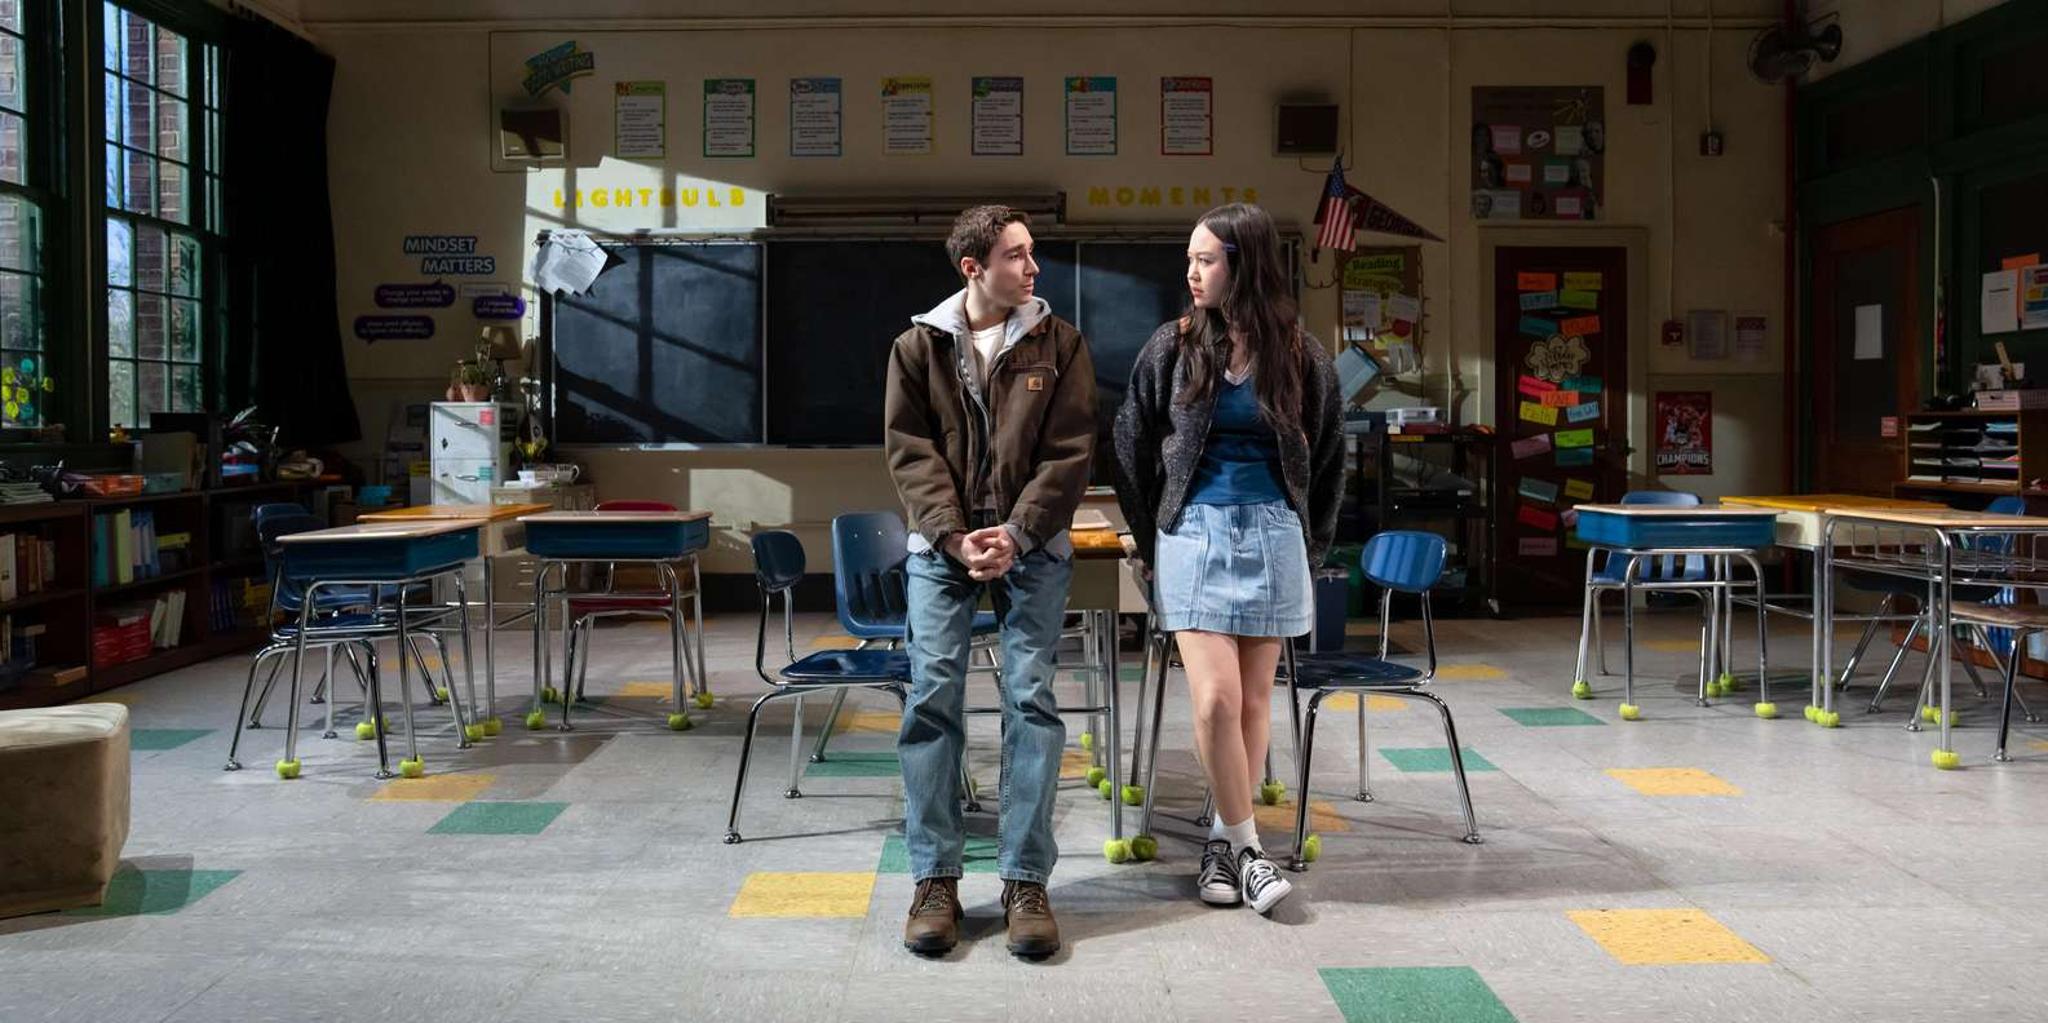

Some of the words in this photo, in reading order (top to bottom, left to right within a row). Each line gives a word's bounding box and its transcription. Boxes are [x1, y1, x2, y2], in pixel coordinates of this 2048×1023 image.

[553, 187, 745, 208] LIGHTBULB
[1088, 186, 1258, 207] MOMENTS
[404, 237, 476, 253] MINDSET
[423, 257, 495, 273] MATTERS
[1352, 257, 1400, 271] Reading
[1656, 453, 1709, 465] CHAMPIONS
